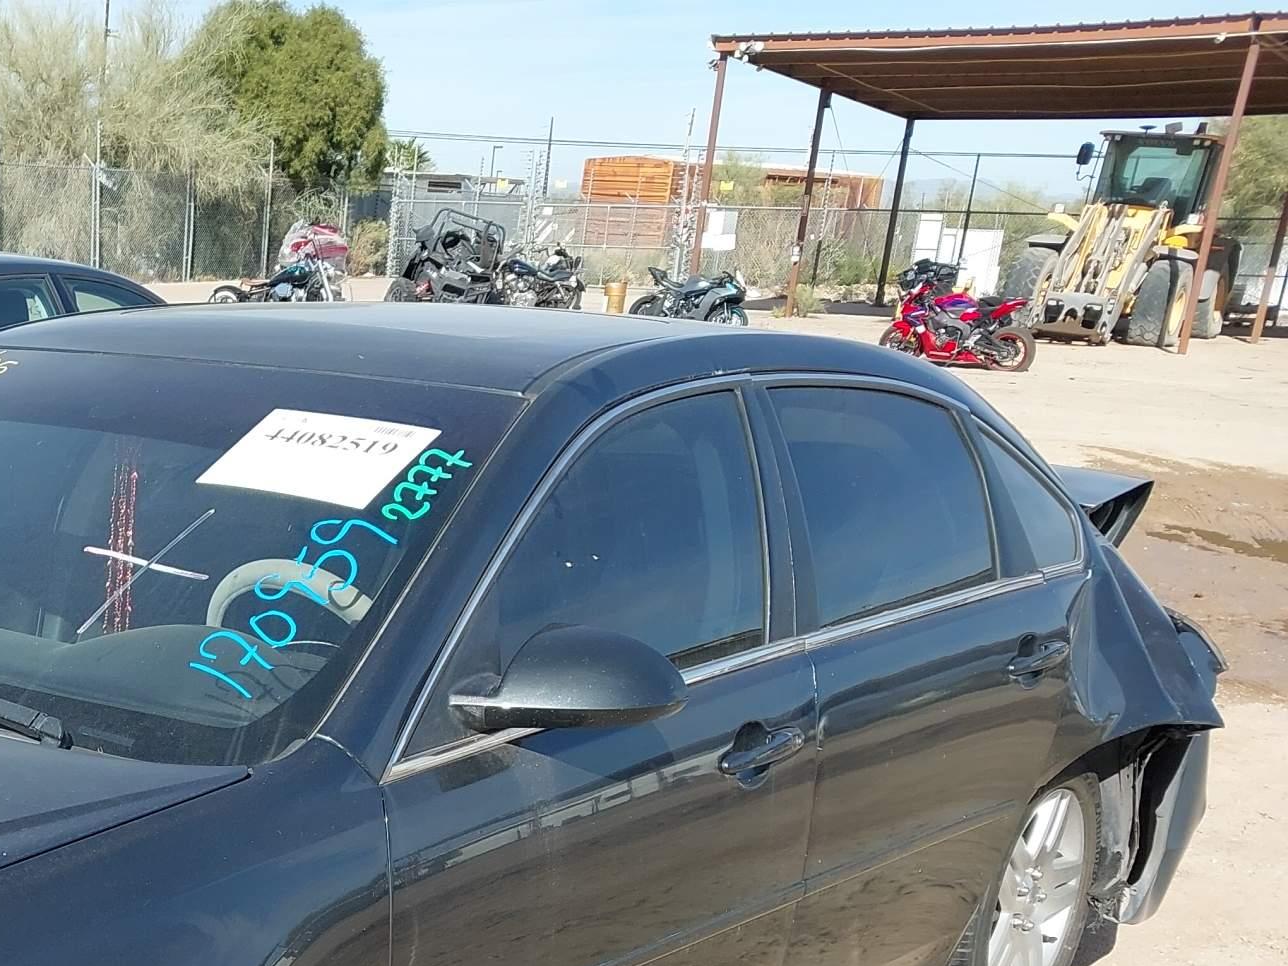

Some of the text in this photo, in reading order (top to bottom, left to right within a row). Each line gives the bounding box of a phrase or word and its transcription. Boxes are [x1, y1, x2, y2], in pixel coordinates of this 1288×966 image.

[263, 427, 400, 456] 44082519
[381, 448, 473, 521] 2777
[189, 519, 399, 699] 170959
